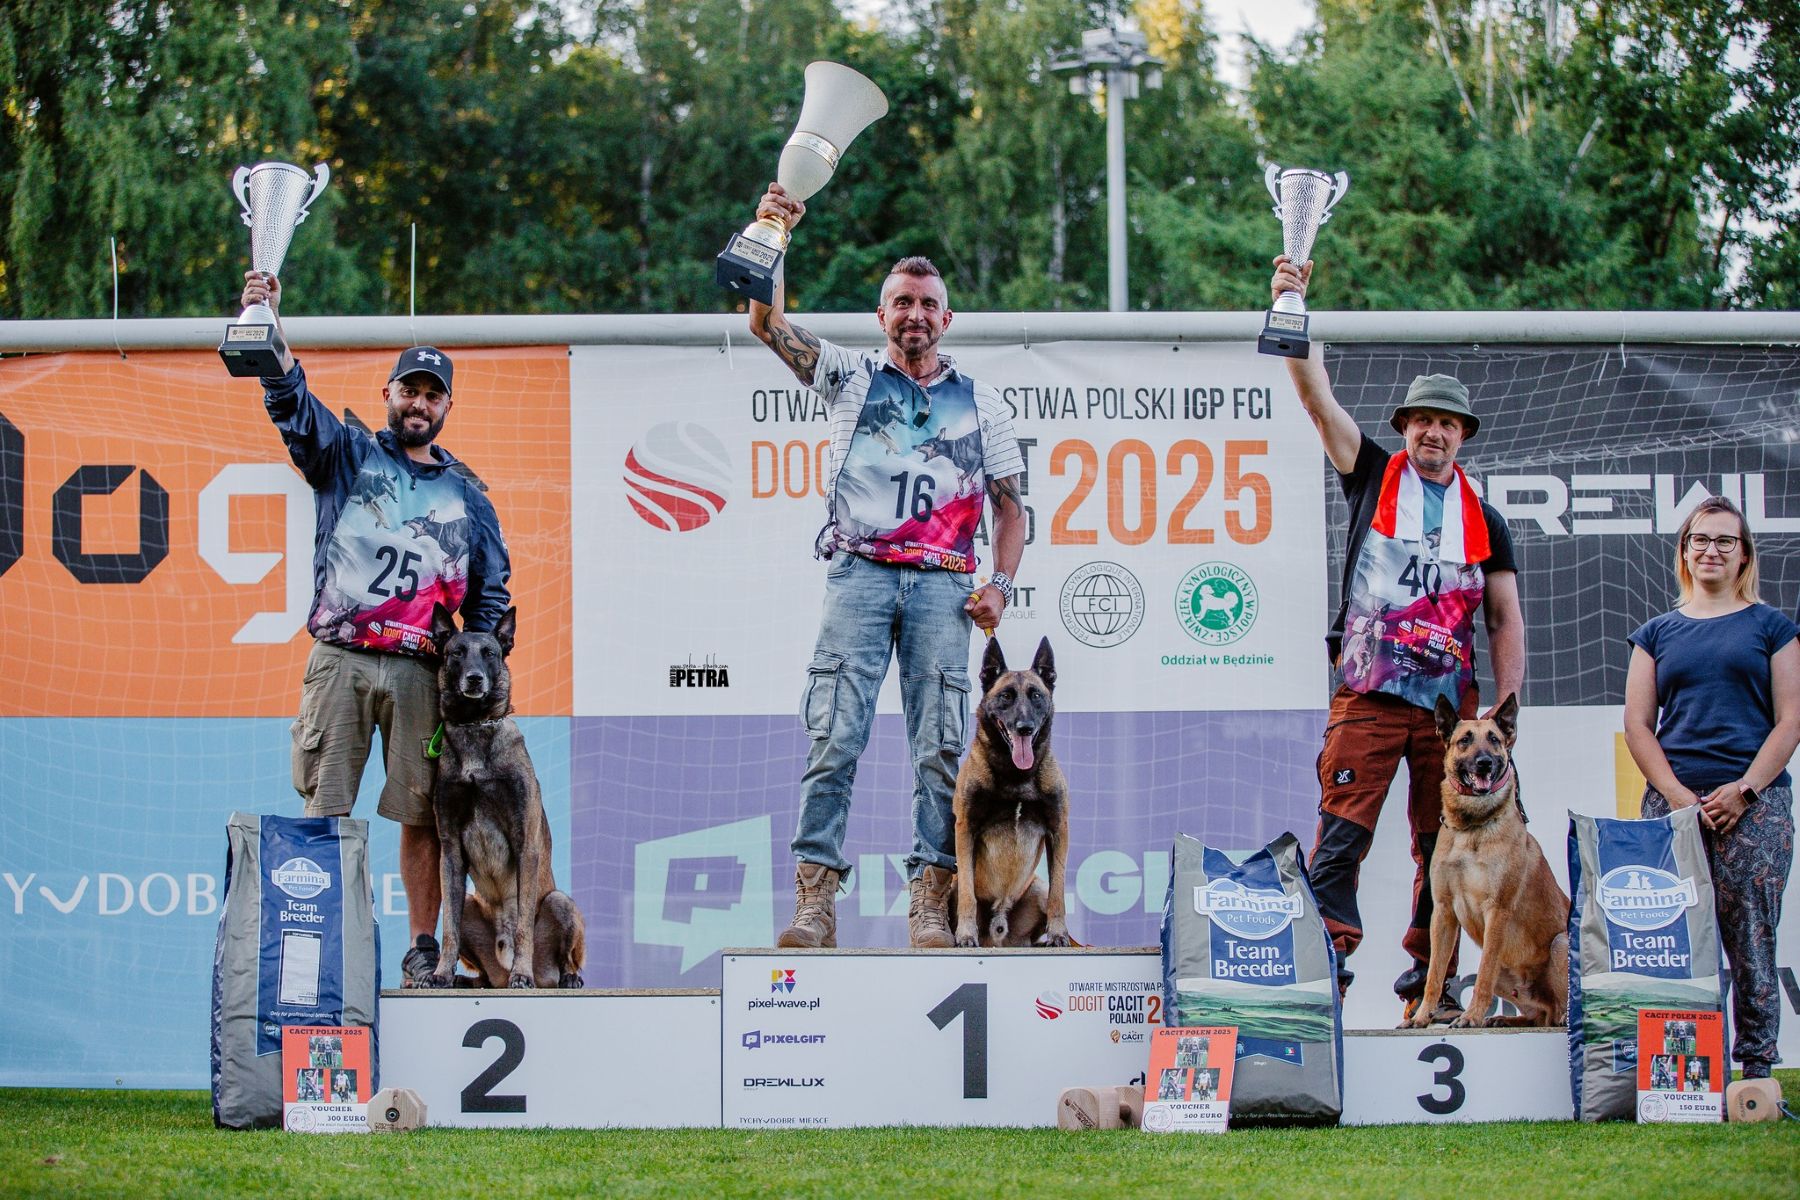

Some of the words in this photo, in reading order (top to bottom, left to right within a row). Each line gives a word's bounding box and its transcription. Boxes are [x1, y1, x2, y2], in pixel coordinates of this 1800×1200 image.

[752, 389, 829, 422] OTWA
[1086, 387, 1175, 420] POLSKI
[1184, 387, 1225, 420] IGP
[1233, 387, 1272, 420] FCI
[889, 470, 936, 523] 16
[1049, 438, 1273, 546] 2025
[1468, 473, 1800, 536] REWL
[940, 554, 967, 573] 2025
[367, 545, 423, 602] 25
[1397, 554, 1443, 606] 40
[1088, 597, 1117, 612] FCI
[1003, 610, 1037, 620] EAGUE
[1161, 654, 1207, 665] Oddział
[1210, 656, 1220, 665] w
[1223, 654, 1274, 667] Będzinie
[278, 872, 325, 884] Farmina
[99, 872, 217, 917] DOB
[1206, 891, 1294, 912] Farmina
[1601, 888, 1687, 907] Farmina
[286, 899, 318, 912] Team
[1620, 911, 1637, 919] Pet
[1640, 911, 1671, 919] Foods
[280, 910, 325, 923] Breeder
[1227, 914, 1243, 923] Pet
[1247, 915, 1276, 925] Foods
[1224, 940, 1280, 960] Team
[1620, 932, 1676, 950] Team
[1215, 959, 1293, 978] Breeder
[1613, 949, 1689, 969] Breeder
[1069, 982, 1103, 992] OTWARTE
[1104, 982, 1156, 992] MISTRZOSTWA
[748, 997, 820, 1011] pixel-wave.pl
[1069, 995, 1105, 1012] DOGIT
[1108, 995, 1145, 1012] CACIT
[1109, 1012, 1144, 1024] POLAND
[926, 983, 988, 1099] 1
[461, 1018, 527, 1114] 2
[743, 1078, 825, 1087] DREWLUX
[1415, 1042, 1467, 1115] 3
